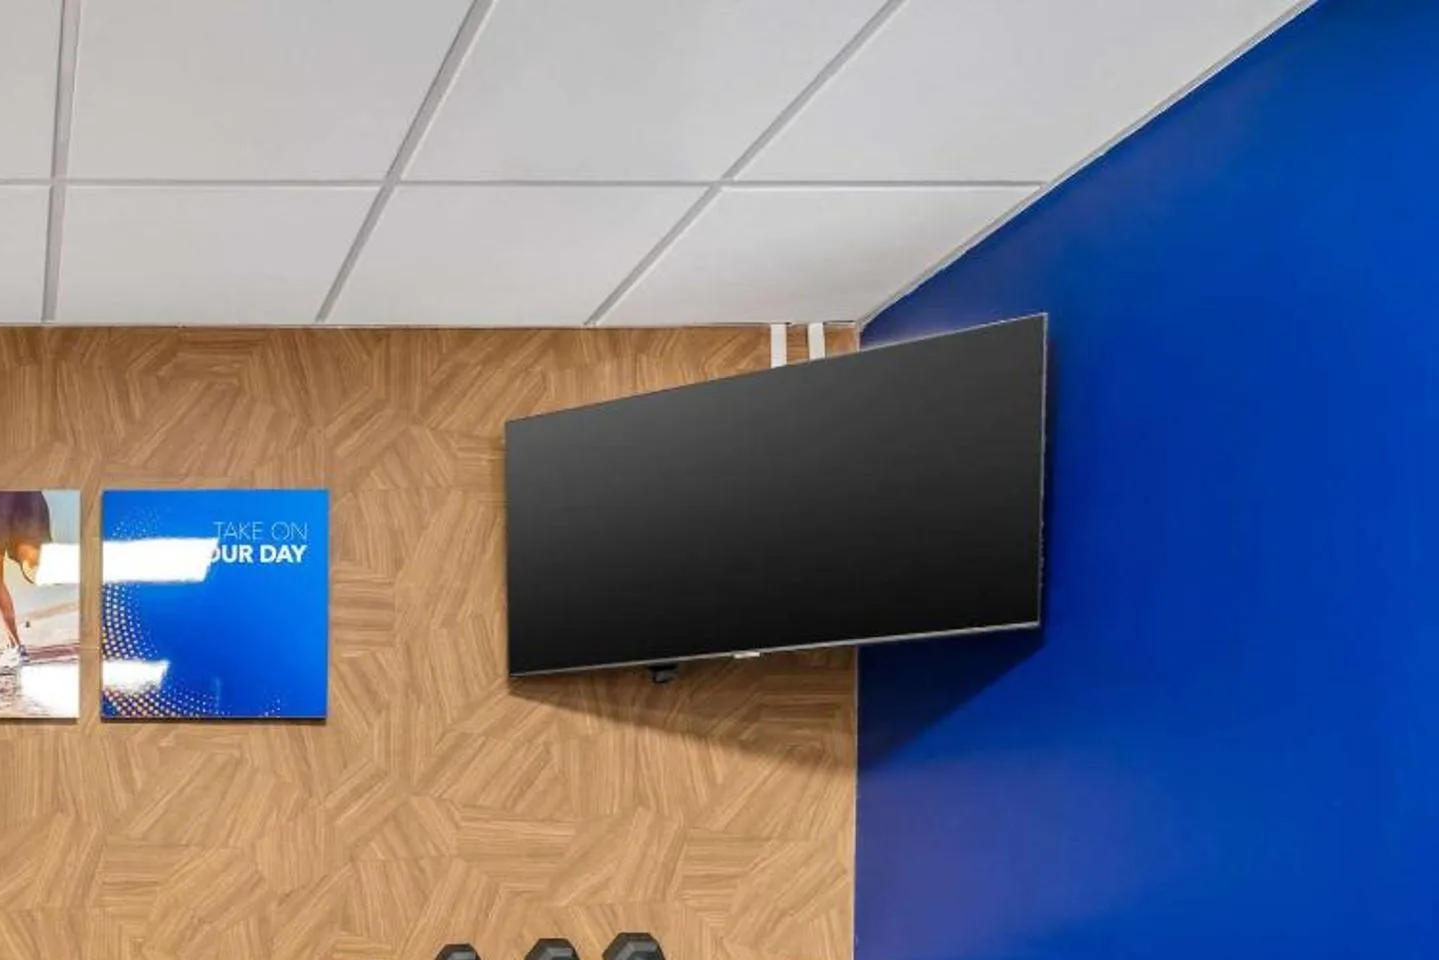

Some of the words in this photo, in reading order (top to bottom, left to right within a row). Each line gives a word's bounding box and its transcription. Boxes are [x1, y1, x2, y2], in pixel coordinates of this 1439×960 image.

[213, 521, 264, 541] TAKE
[271, 521, 308, 541] ON
[209, 544, 253, 563] OUR
[260, 544, 308, 563] DAY
